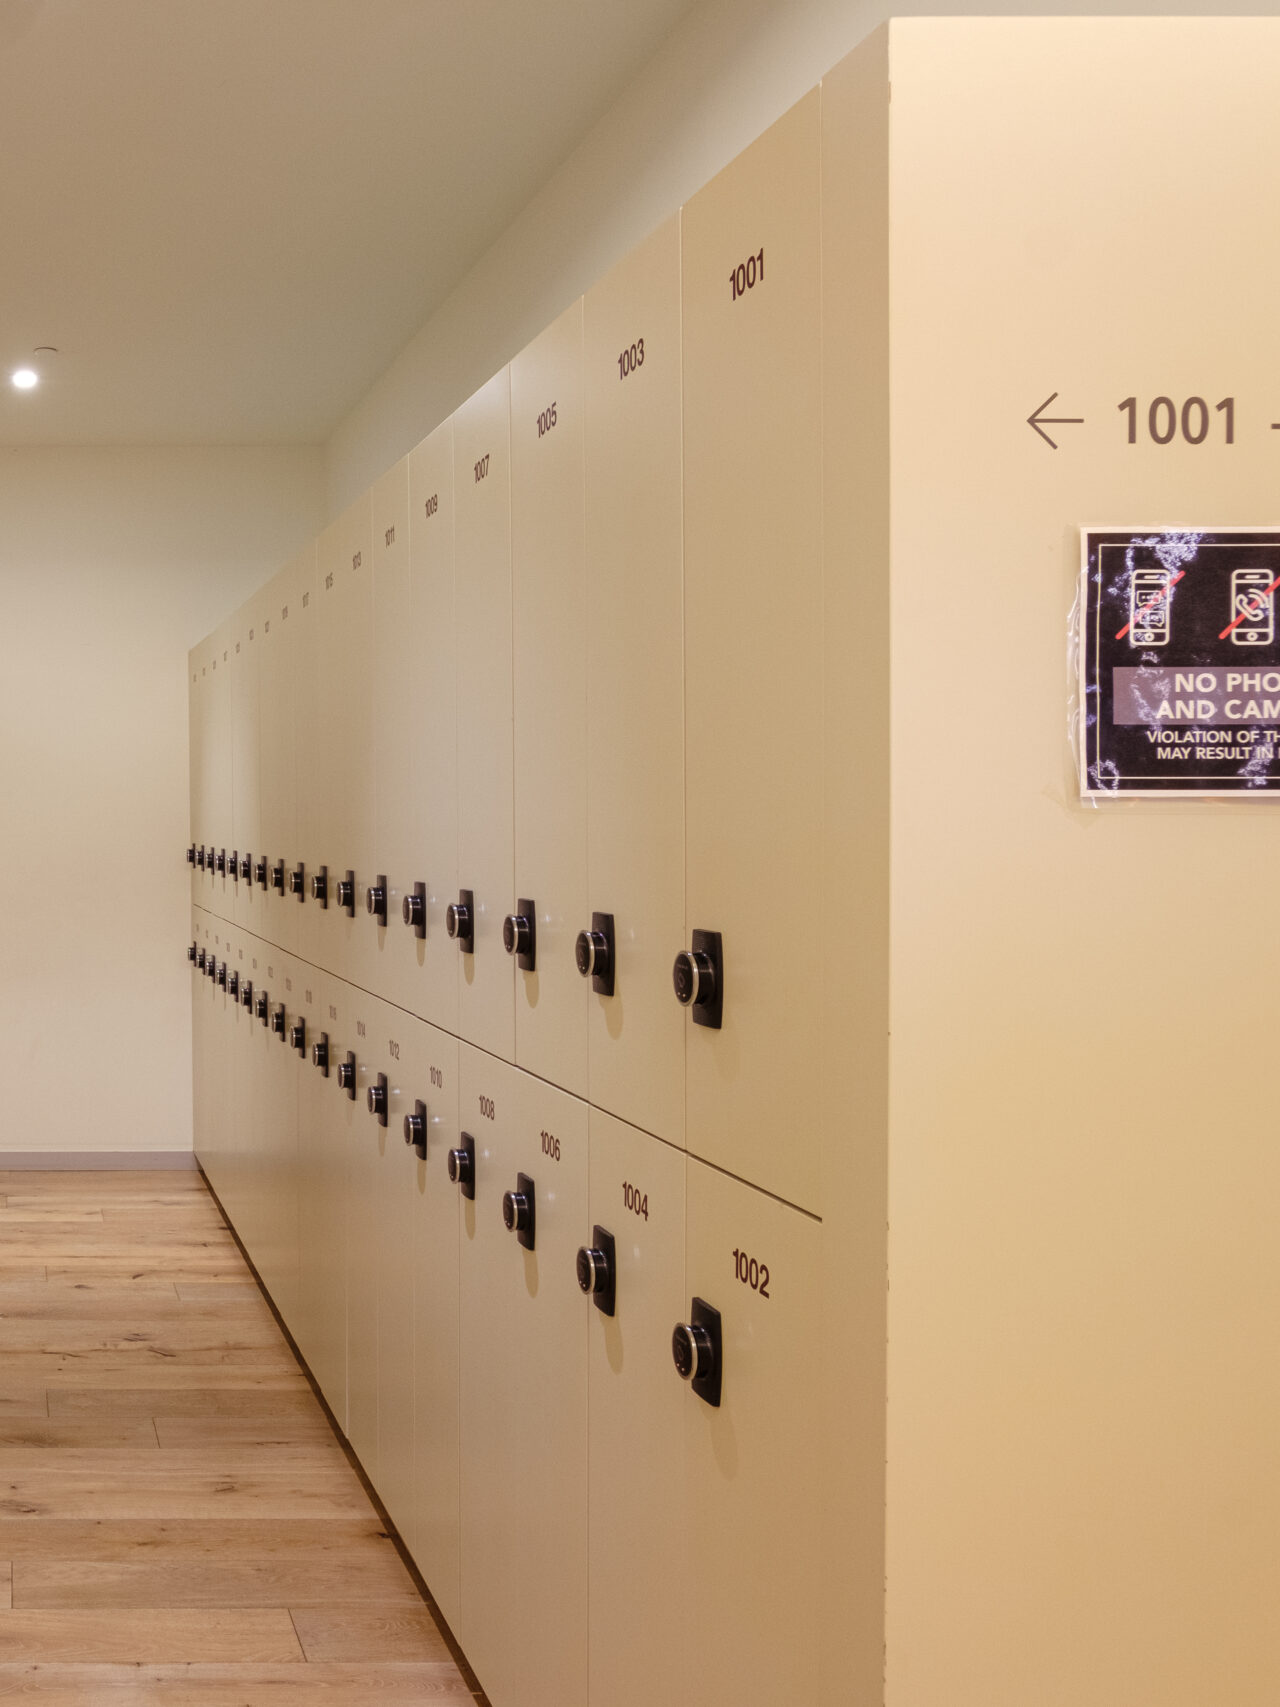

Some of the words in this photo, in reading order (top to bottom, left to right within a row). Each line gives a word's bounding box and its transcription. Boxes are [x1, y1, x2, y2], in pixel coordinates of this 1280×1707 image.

[729, 247, 764, 301] 1001
[618, 338, 645, 381] 1003
[537, 401, 557, 438] 1005
[1117, 396, 1235, 445] 1001
[474, 453, 490, 484] 1007
[425, 493, 438, 519] 1009
[1175, 673, 1217, 693] NO
[1226, 673, 1280, 693] PHO
[1155, 700, 1216, 719] AND
[1224, 699, 1280, 719] CAM
[1147, 730, 1232, 744] VIOLATION
[1236, 730, 1260, 744] OF
[1157, 747, 1192, 759] MAY
[1195, 747, 1252, 759] RESULT
[1256, 747, 1274, 759] IN
[389, 1040, 400, 1061] 1012
[429, 1065, 443, 1089] 1010
[479, 1094, 495, 1121] 1008
[540, 1129, 560, 1161] 1006
[622, 1180, 648, 1221] 1004
[732, 1248, 769, 1299] 1002
